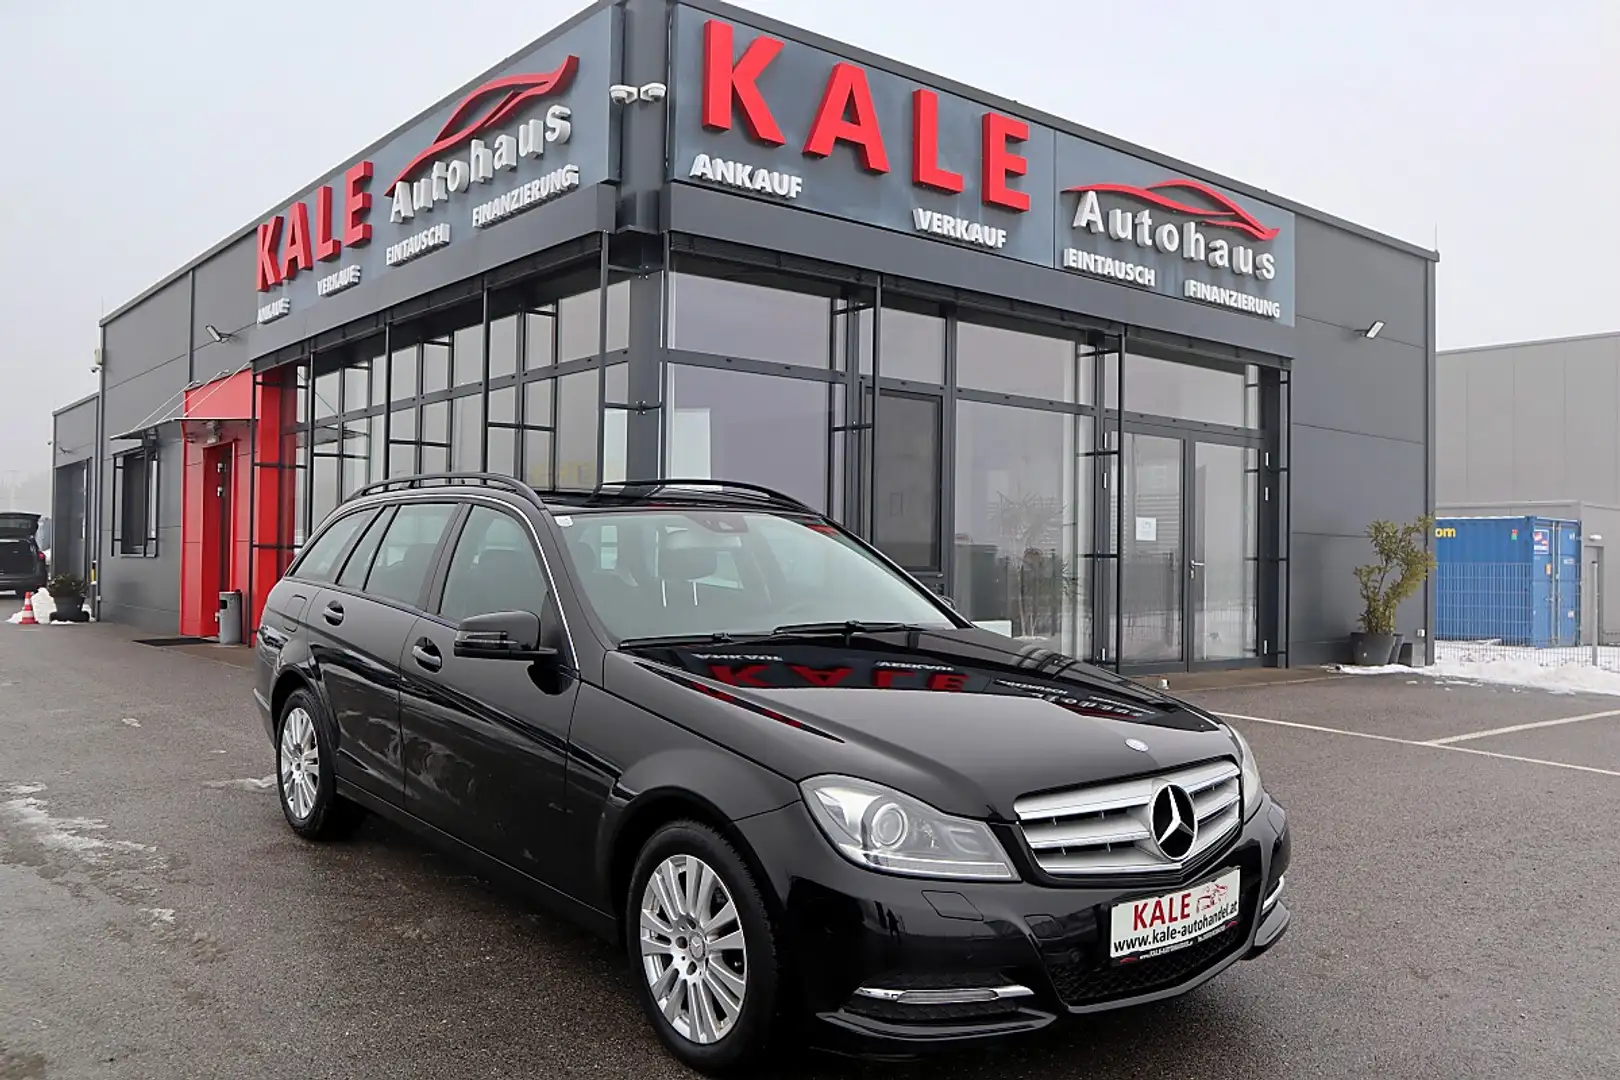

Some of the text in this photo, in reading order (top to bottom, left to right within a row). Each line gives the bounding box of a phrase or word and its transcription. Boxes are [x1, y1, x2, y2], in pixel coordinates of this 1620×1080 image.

[702, 19, 1030, 212] KALE
[390, 104, 572, 223] Autohaus
[689, 153, 804, 199] ANKAUF
[472, 163, 580, 229] FINANZIERUNG
[256, 160, 374, 293] KALE
[386, 222, 450, 267] EINTAUSCH
[912, 207, 1007, 249] VERKAUF
[1072, 190, 1276, 281] Autohaus
[1063, 247, 1156, 288] EINTAUSCH
[1184, 278, 1281, 319] FINANZIERUNG
[1113, 900, 1238, 953] www.kale-autohandel.at
[1132, 892, 1192, 931] KALE
